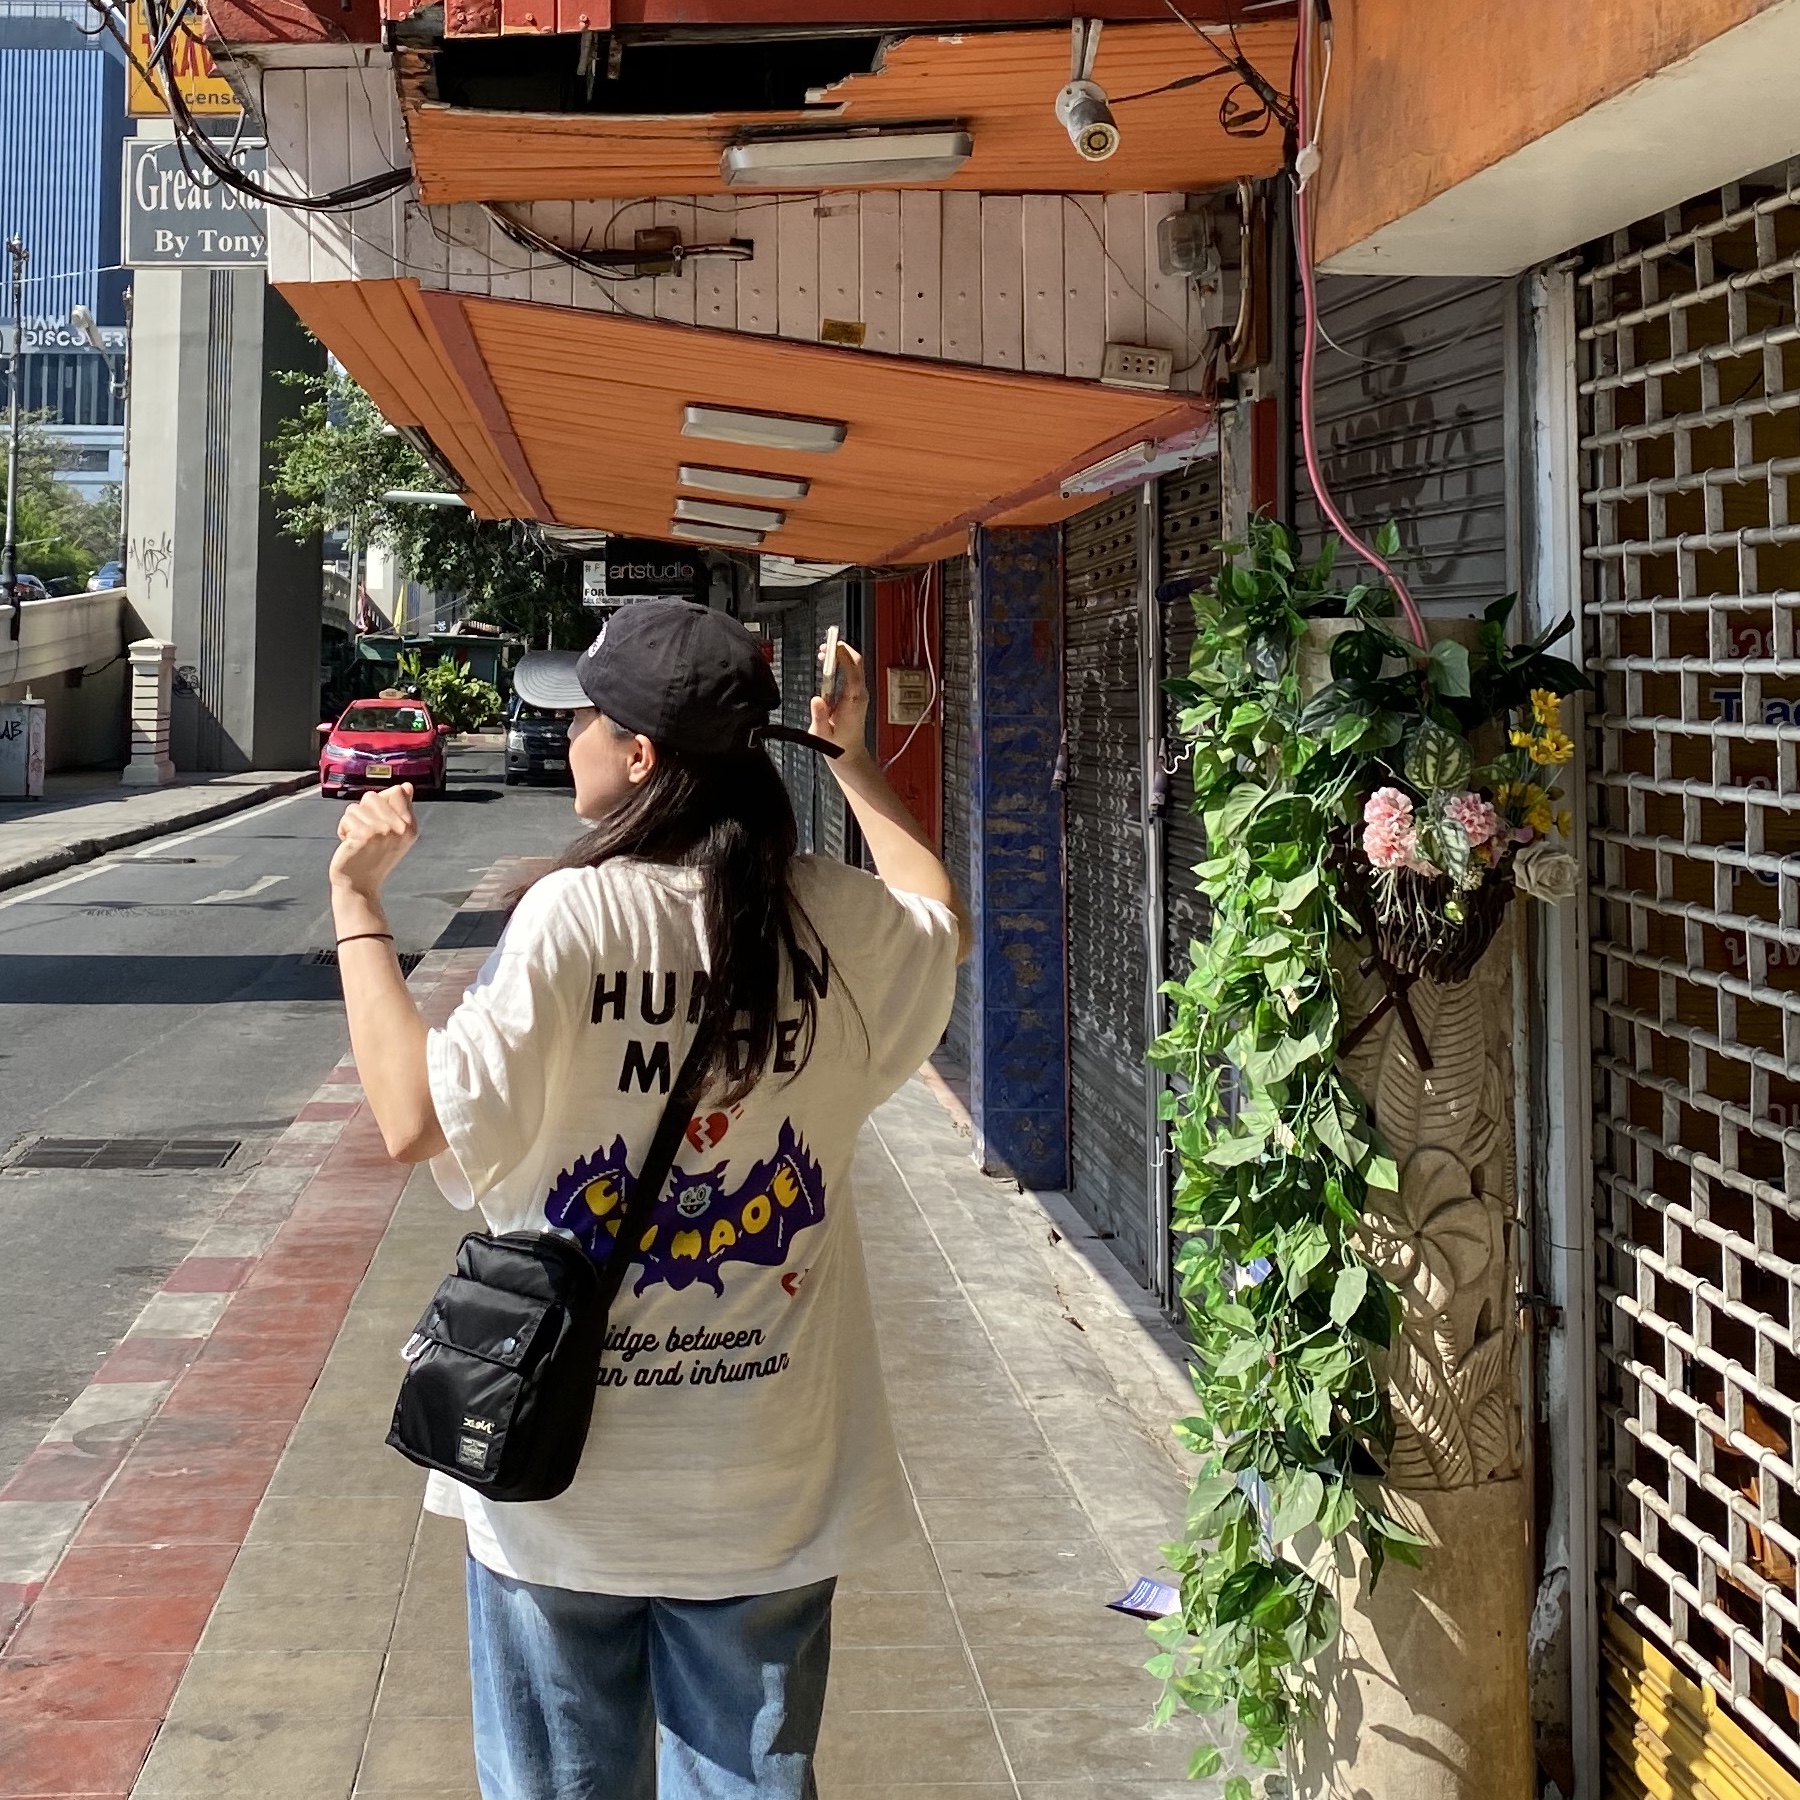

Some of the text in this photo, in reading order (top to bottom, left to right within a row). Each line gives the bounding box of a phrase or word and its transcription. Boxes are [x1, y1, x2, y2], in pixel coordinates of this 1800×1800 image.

[135, 152, 213, 211] Great
[154, 229, 189, 258] By
[609, 562, 695, 579] artstudio
[584, 588, 605, 596] FOR
[618, 1019, 800, 1095] MDE
[665, 1326, 766, 1352] between
[634, 1360, 684, 1387] and
[689, 1352, 790, 1385] inhuman
